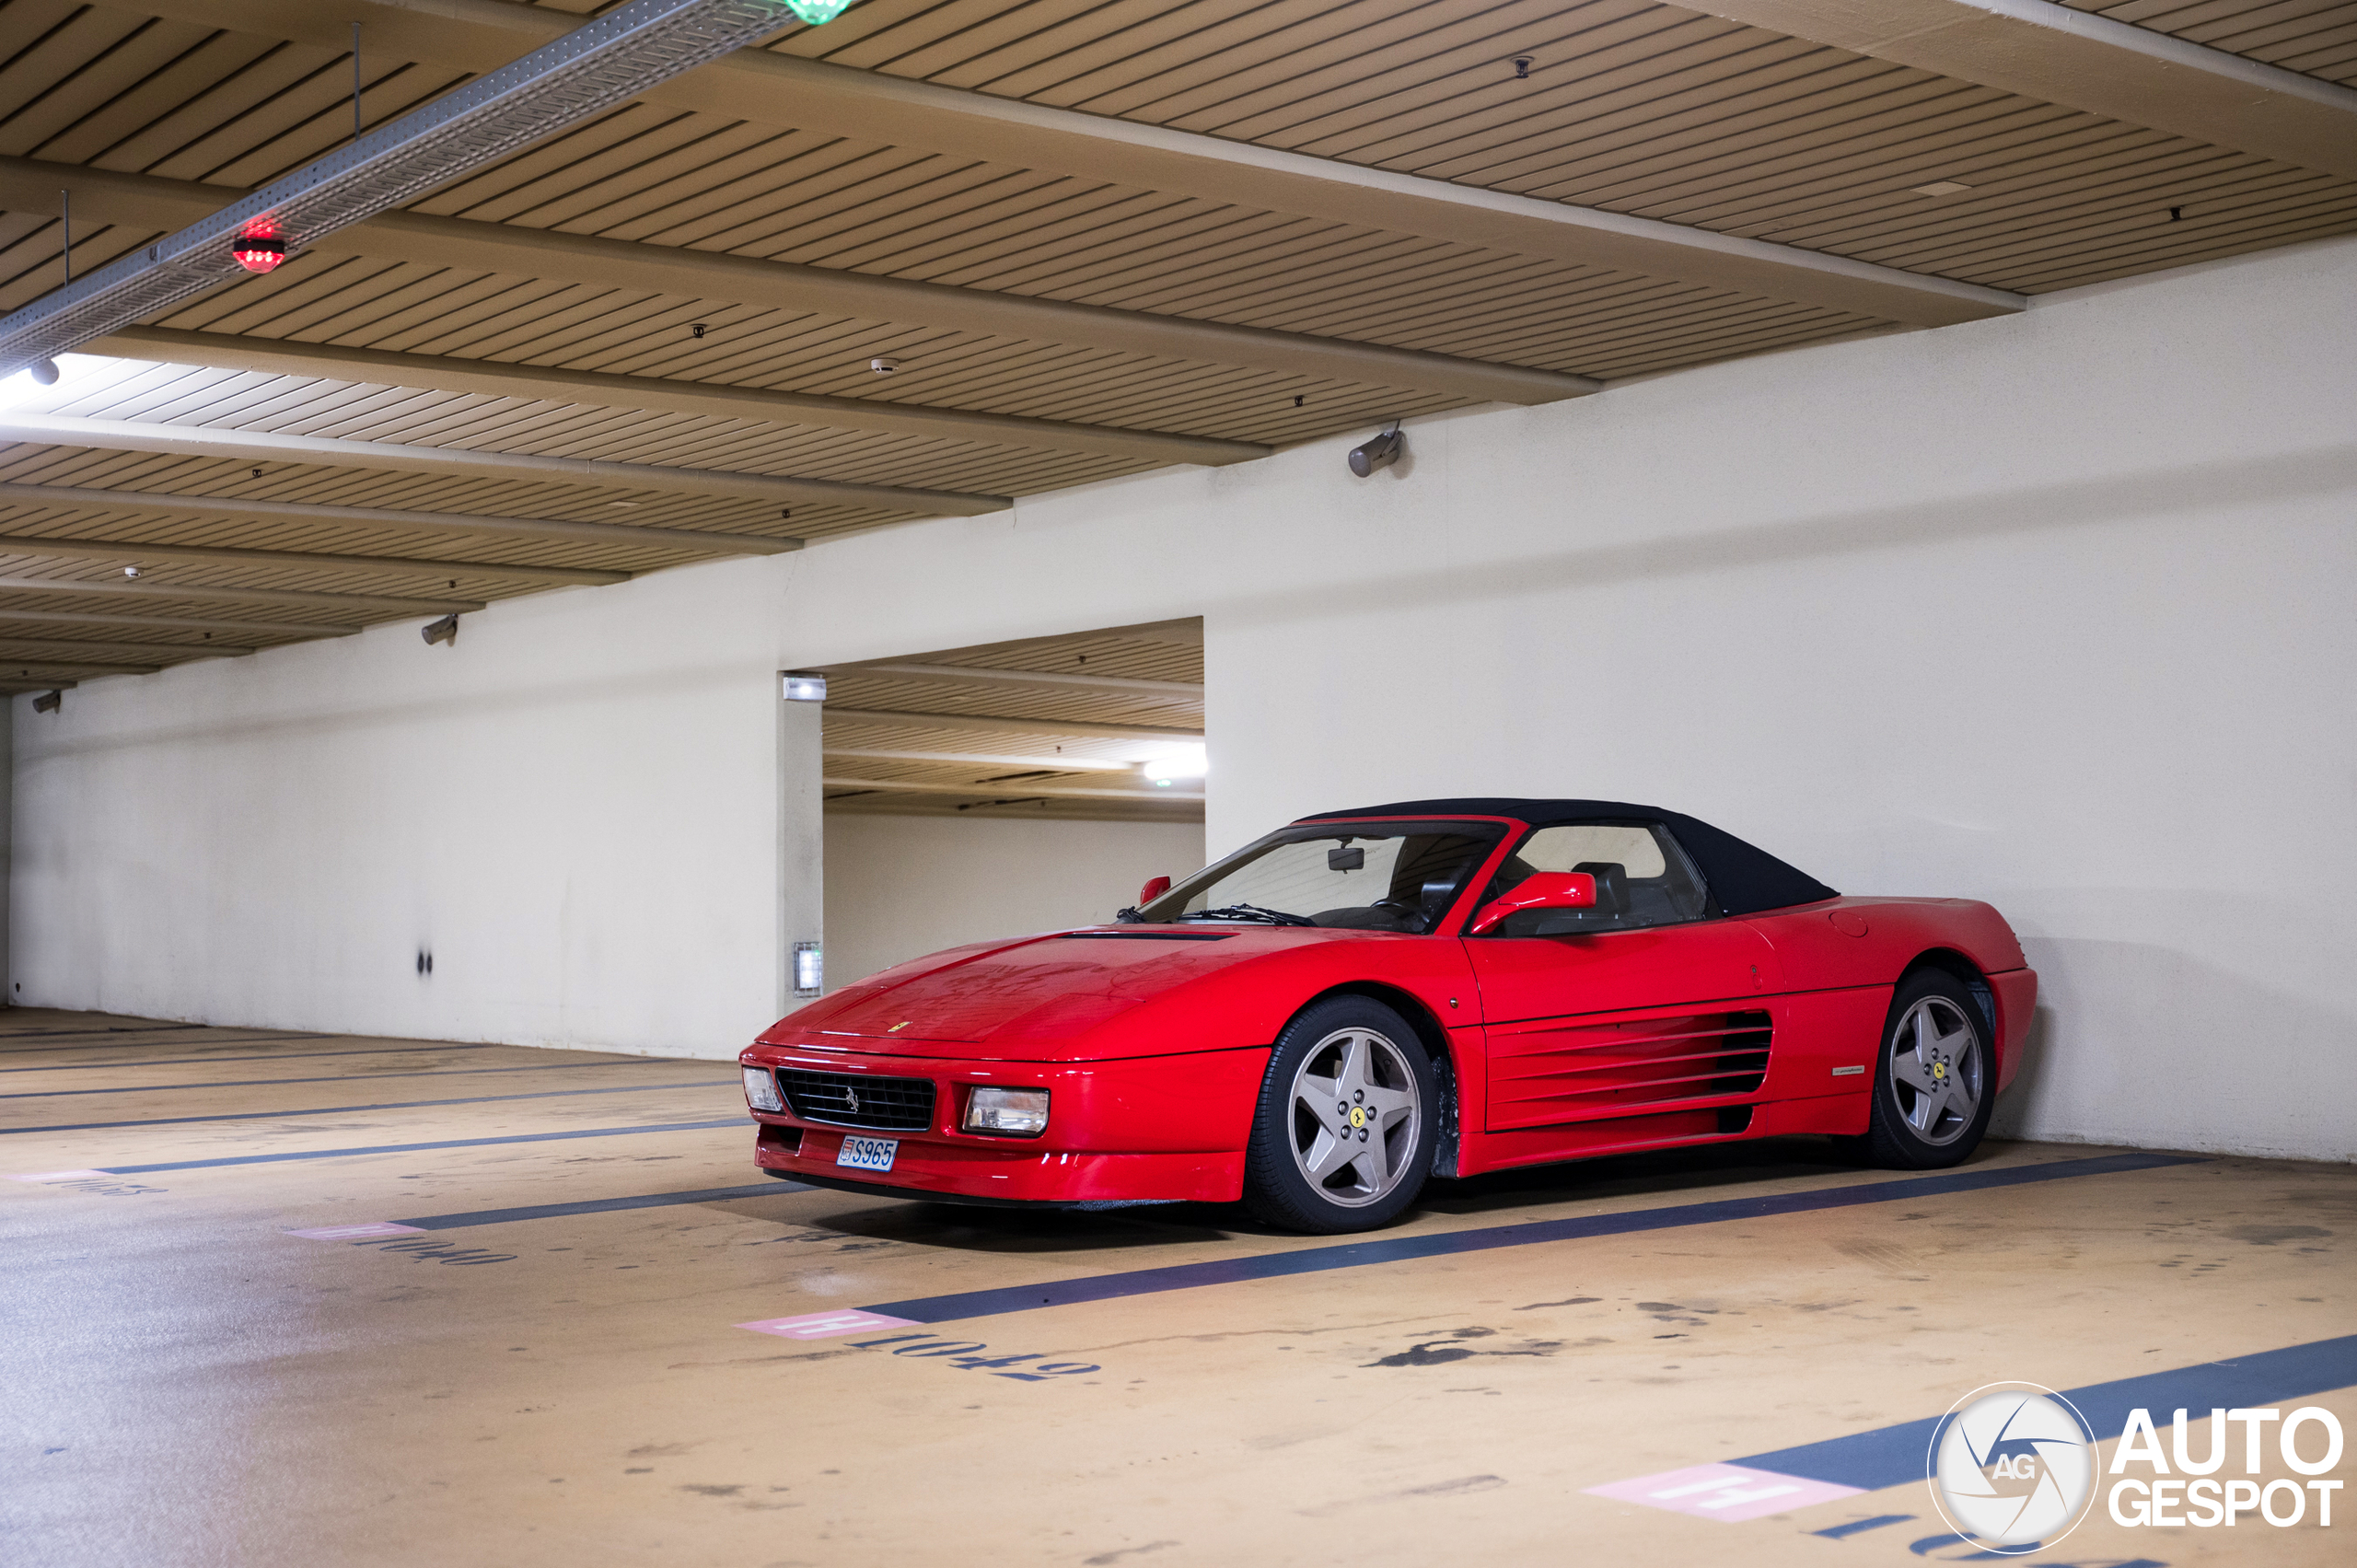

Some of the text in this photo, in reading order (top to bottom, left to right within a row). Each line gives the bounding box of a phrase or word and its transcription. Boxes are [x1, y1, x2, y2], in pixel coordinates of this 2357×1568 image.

[853, 1140, 894, 1167] S965
[348, 1236, 518, 1266] 1040
[772, 1315, 885, 1334] H
[842, 1333, 1102, 1382] 1042
[1648, 1476, 1803, 1510] H
